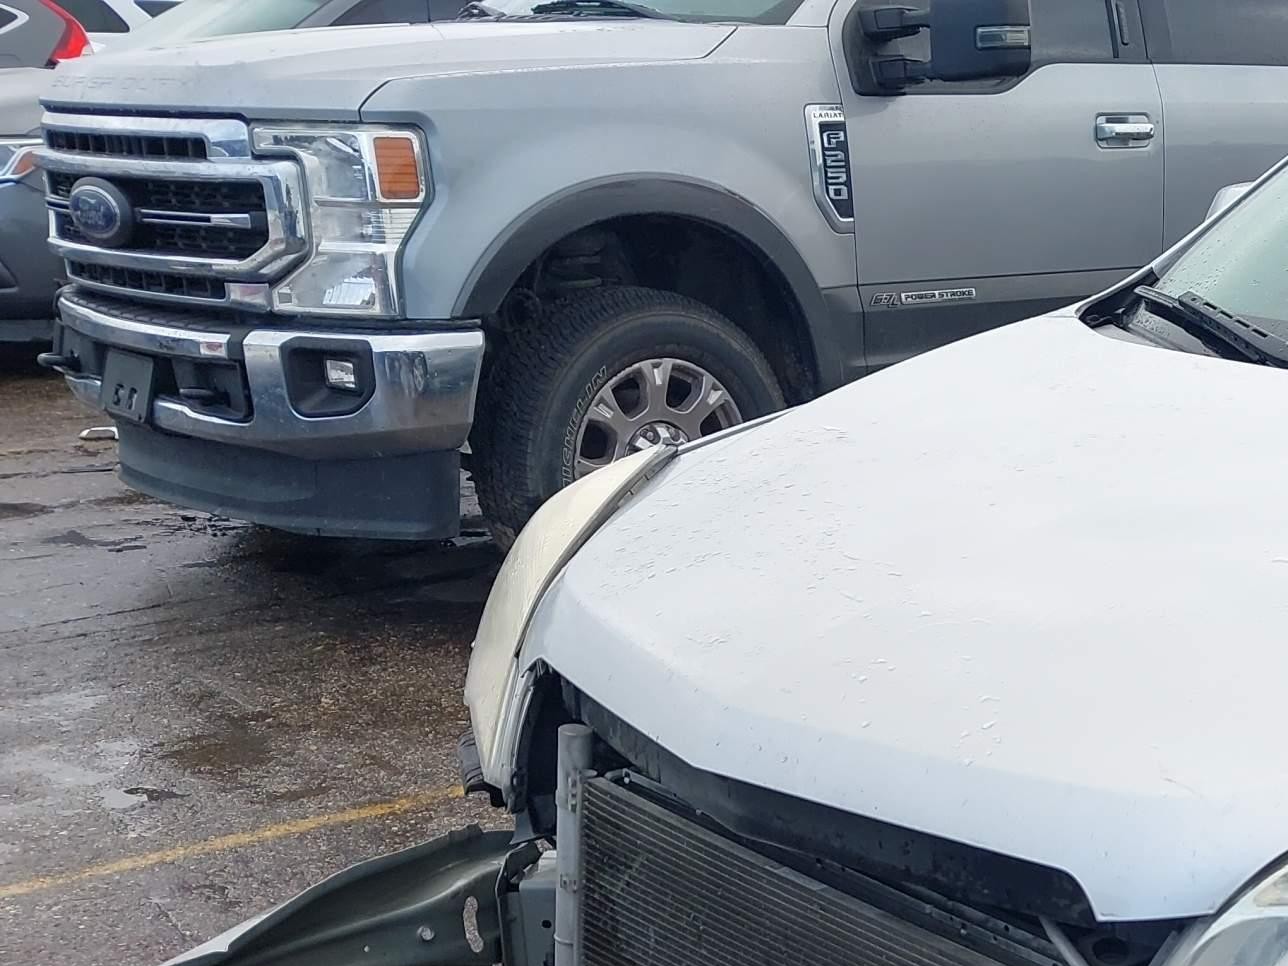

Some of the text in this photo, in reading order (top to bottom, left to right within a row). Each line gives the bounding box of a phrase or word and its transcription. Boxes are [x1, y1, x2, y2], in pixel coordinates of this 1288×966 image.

[822, 130, 849, 200] F250
[904, 293, 936, 301] POWER
[938, 289, 975, 299] STROKE
